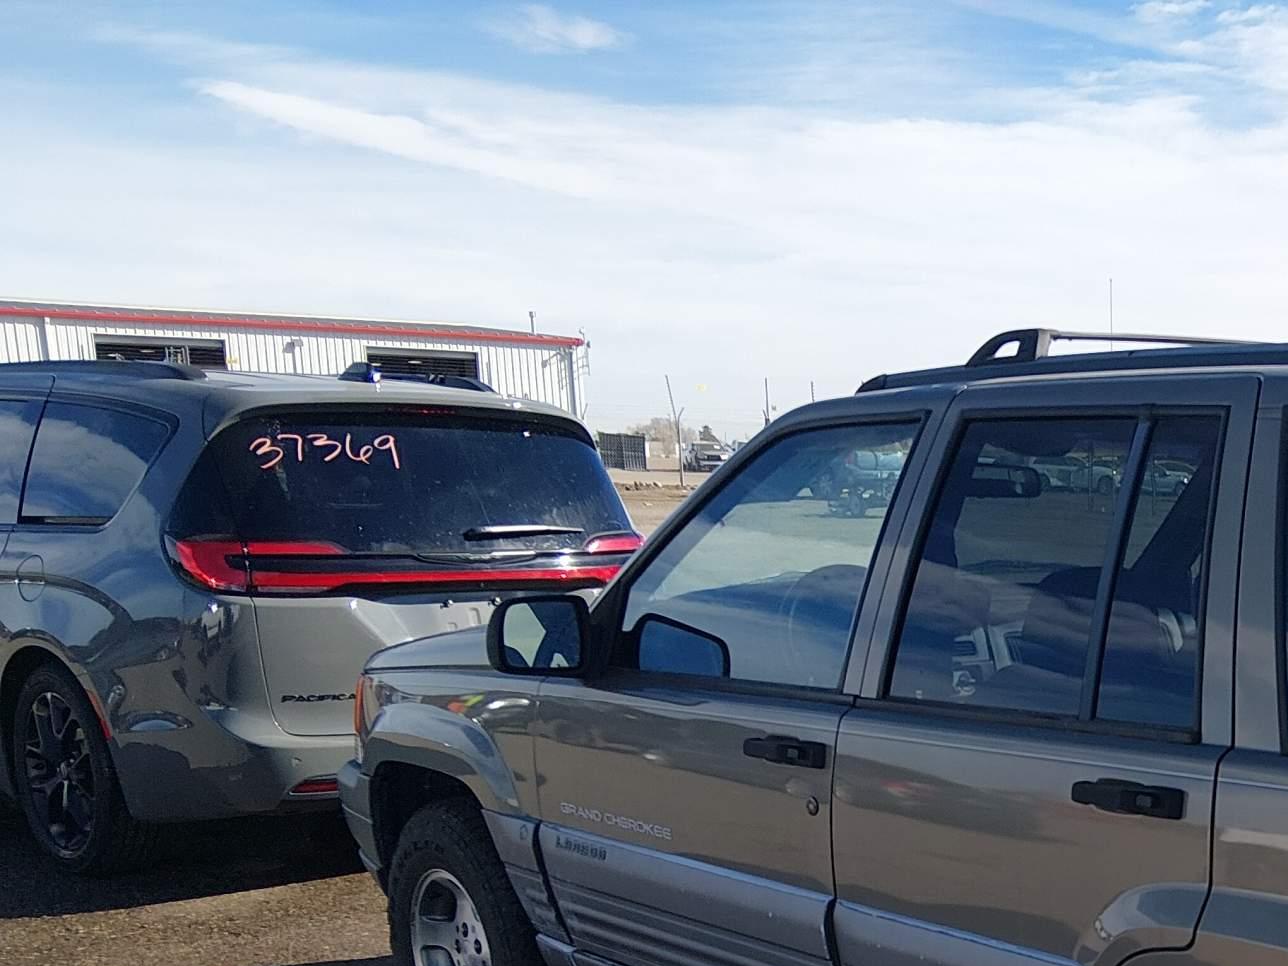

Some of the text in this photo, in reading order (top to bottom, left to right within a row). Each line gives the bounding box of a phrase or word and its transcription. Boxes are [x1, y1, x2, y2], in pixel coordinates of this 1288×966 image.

[249, 432, 400, 470] 37369
[560, 802, 673, 841] GRAND CHEROKEE
